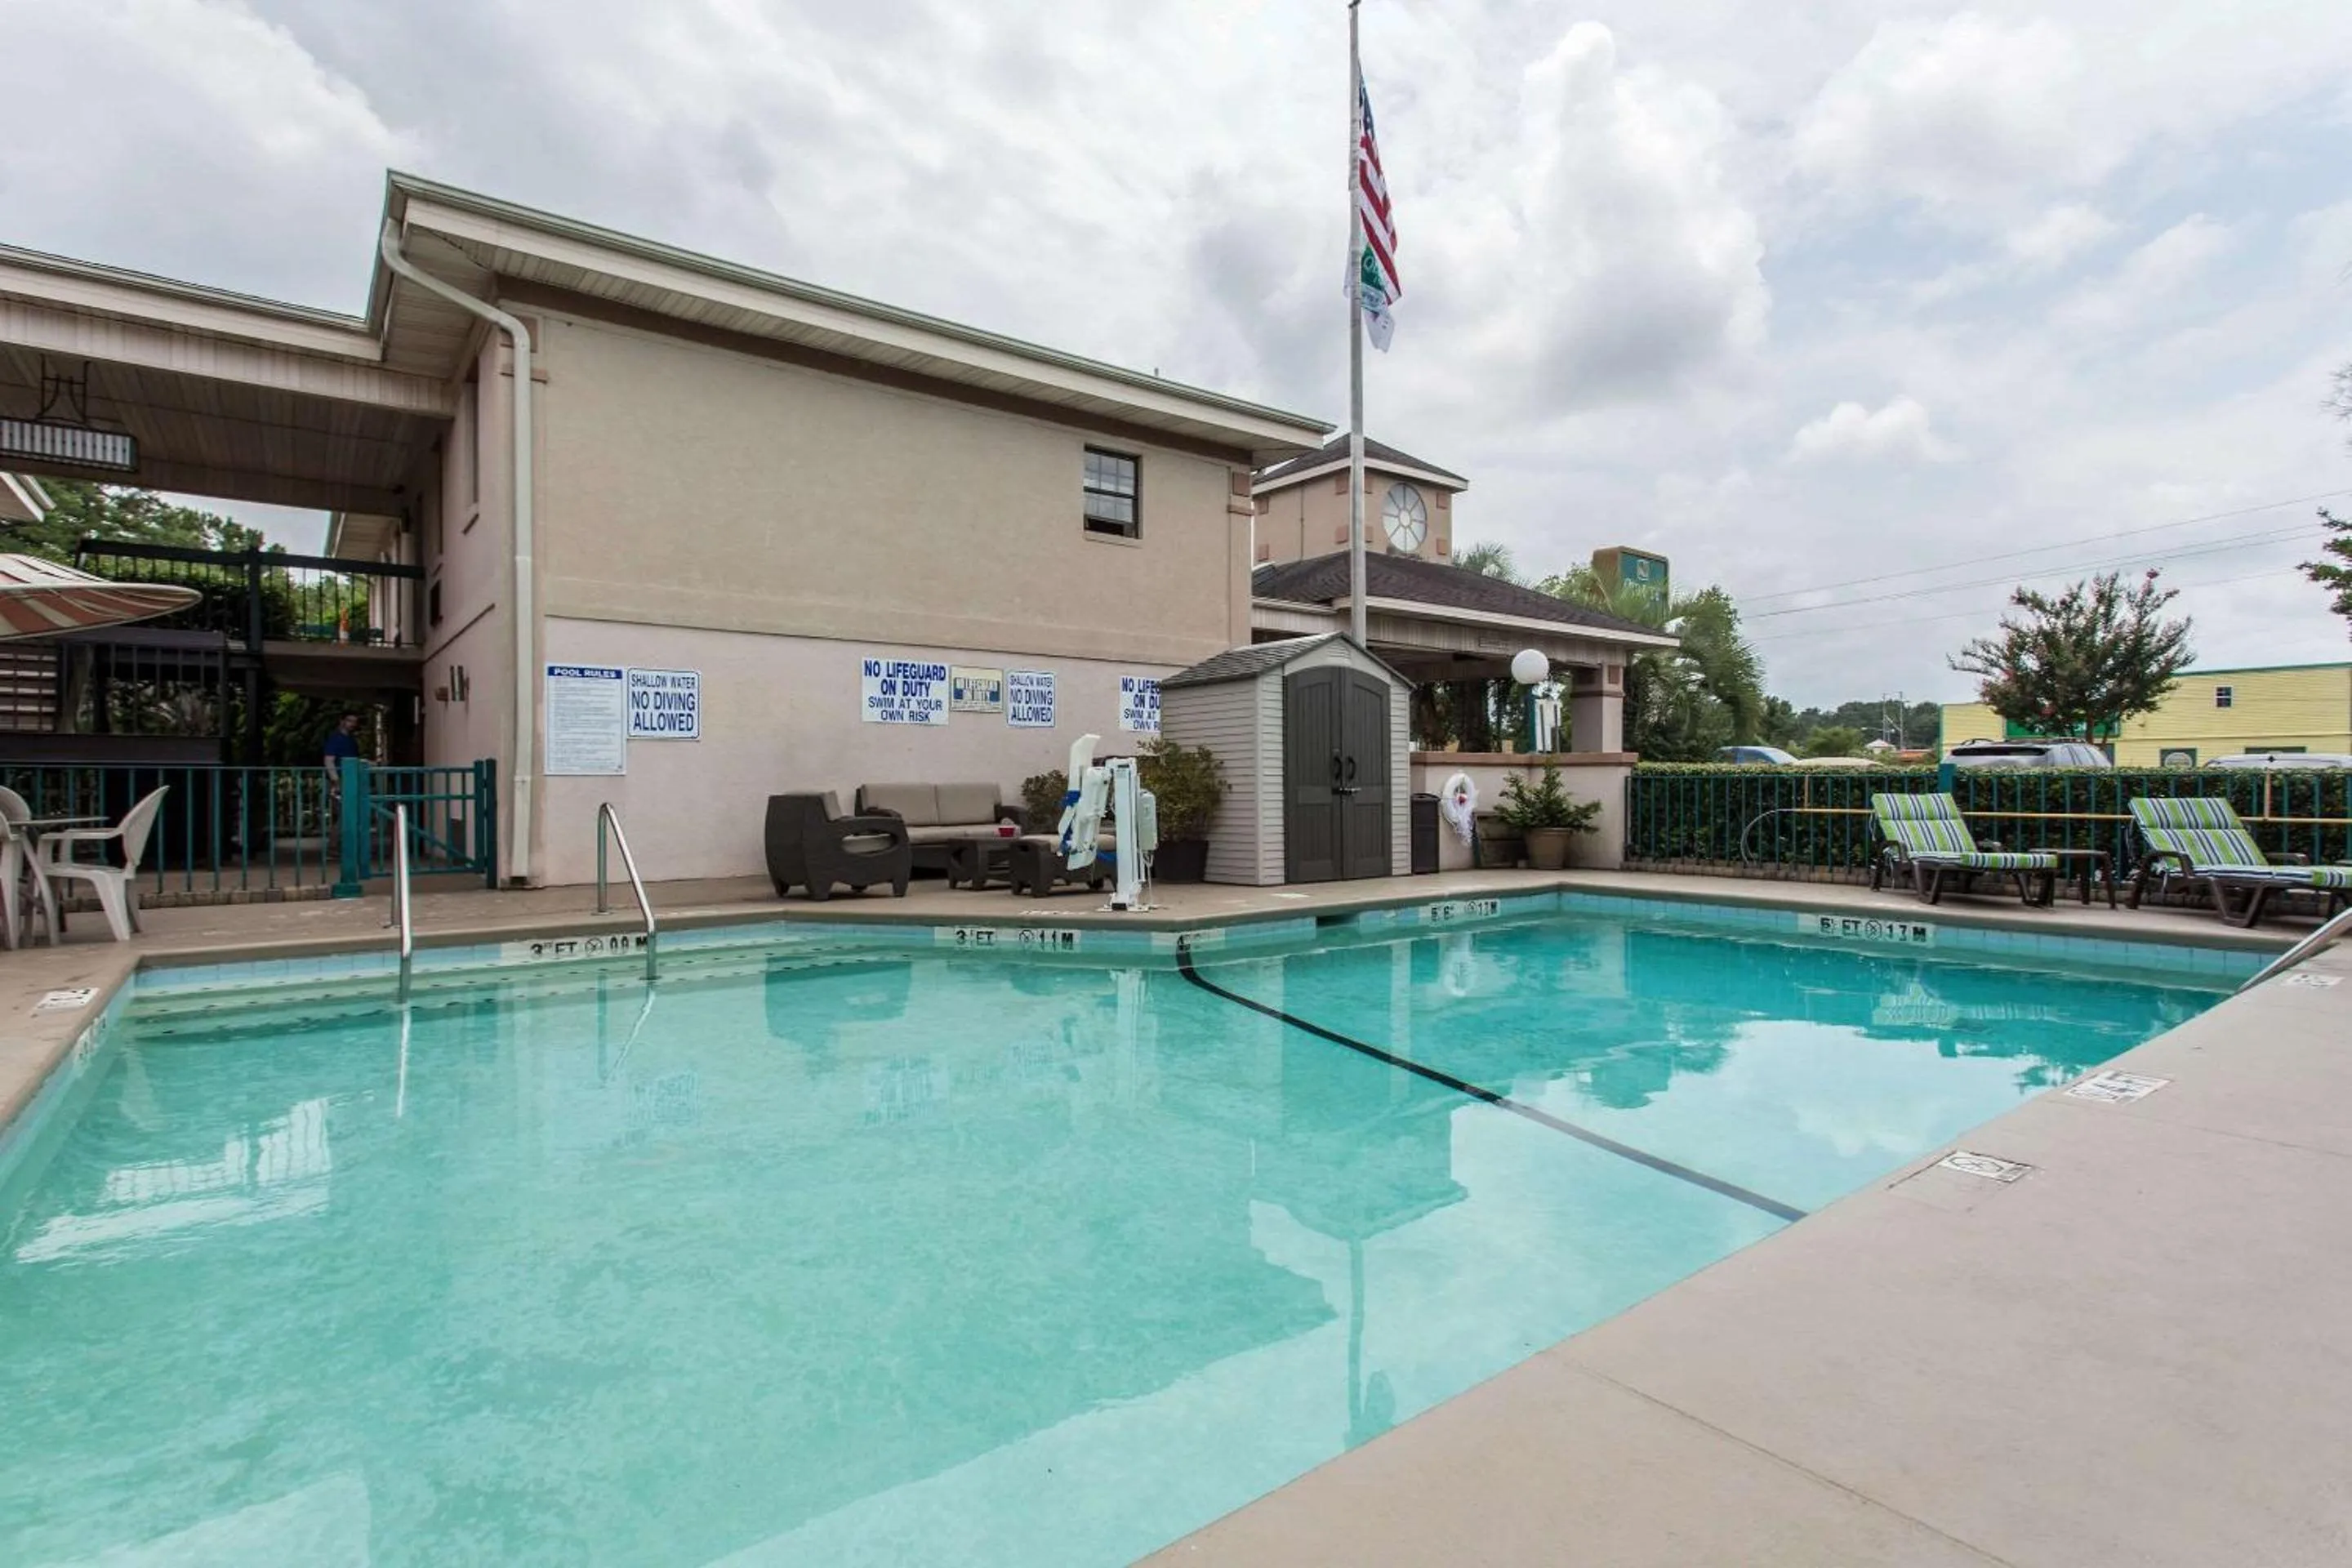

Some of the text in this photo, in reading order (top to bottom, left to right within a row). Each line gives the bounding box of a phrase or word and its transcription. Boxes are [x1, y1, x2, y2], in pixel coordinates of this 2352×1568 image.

[555, 668, 616, 679] POOL RULES
[864, 660, 946, 681] NO LIFEGUARD
[631, 674, 695, 688] SHALLOW WATER
[880, 679, 931, 697] ON DUTY
[1121, 677, 1134, 693] NO
[631, 691, 695, 710] NO DIVING
[868, 696, 942, 710] SWIM AT YOUR
[1009, 688, 1023, 704] NO
[1025, 689, 1053, 706] DIVING
[1134, 694, 1160, 710] ON DU
[633, 711, 694, 731] ALLOWED
[880, 710, 930, 723] OWN RISK
[1011, 706, 1053, 723] ALLOWED
